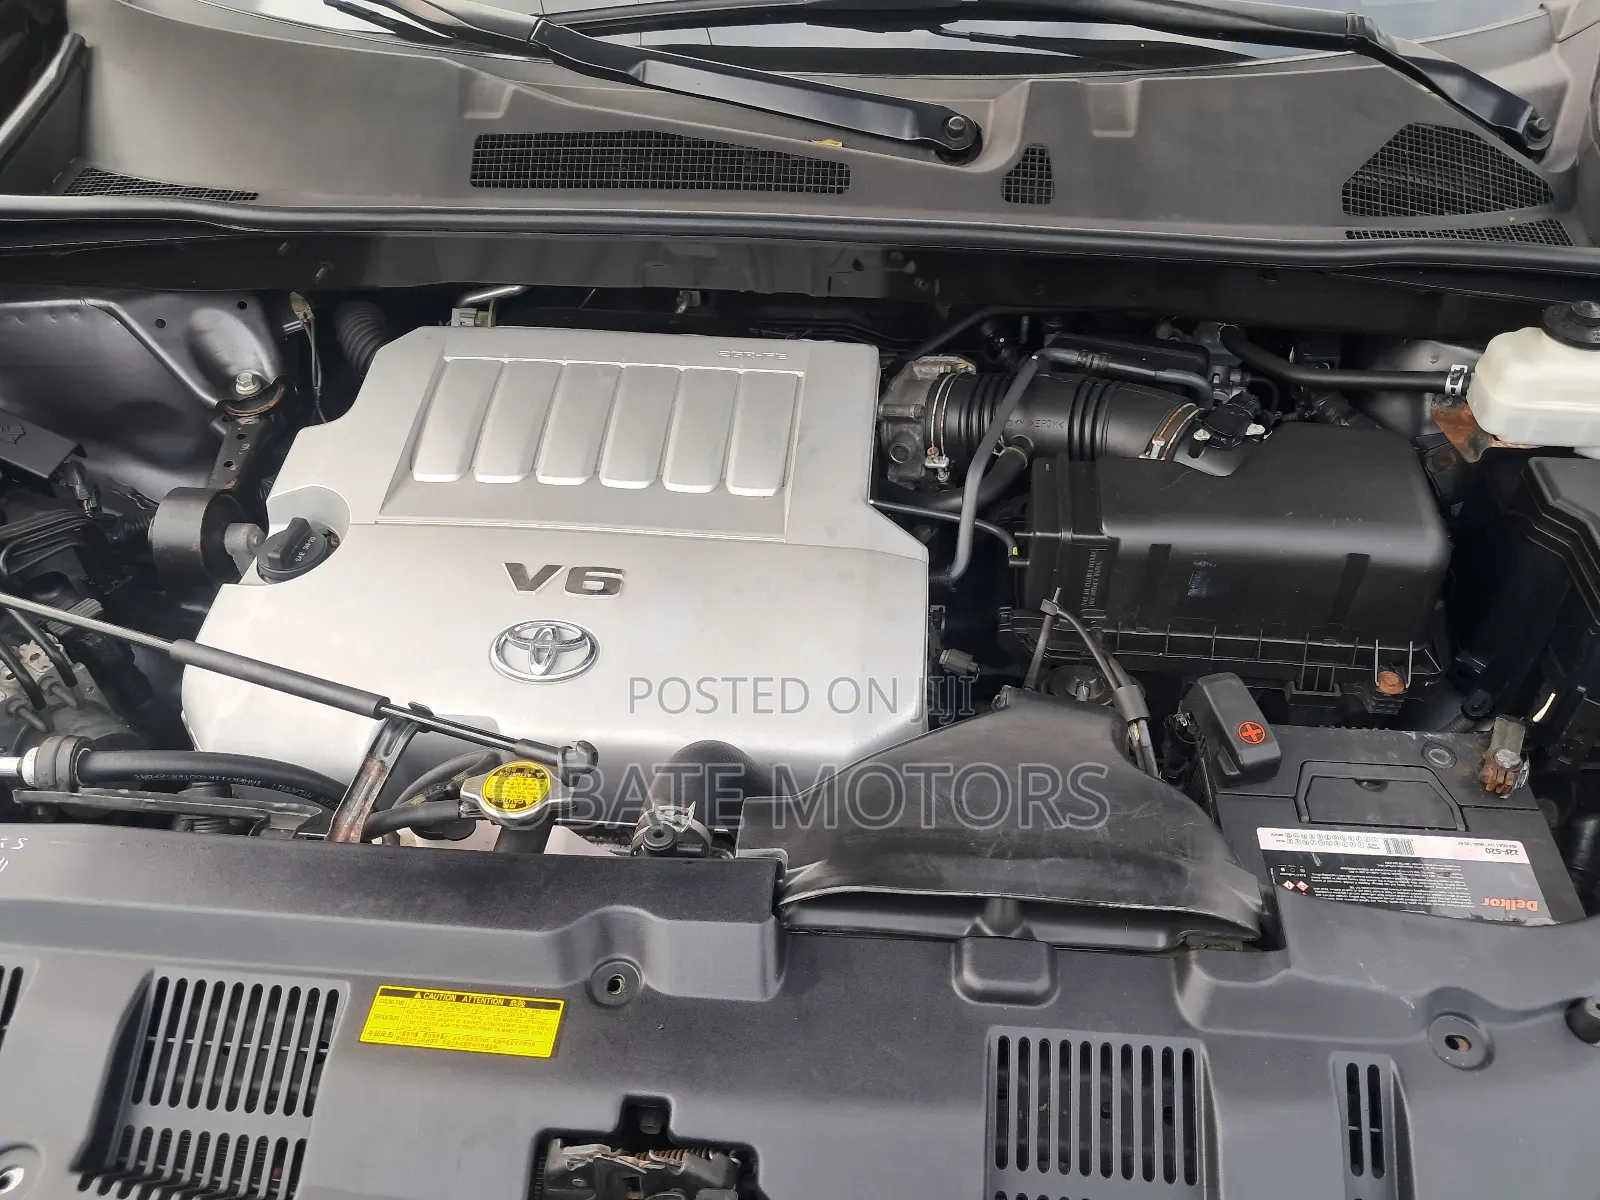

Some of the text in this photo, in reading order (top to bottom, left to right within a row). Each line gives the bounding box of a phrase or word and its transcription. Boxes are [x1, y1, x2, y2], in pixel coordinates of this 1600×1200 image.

[501, 561, 626, 599] V6
[1480, 897, 1539, 913] Delkor
[423, 991, 505, 1006] CAUTION ATTENTION
